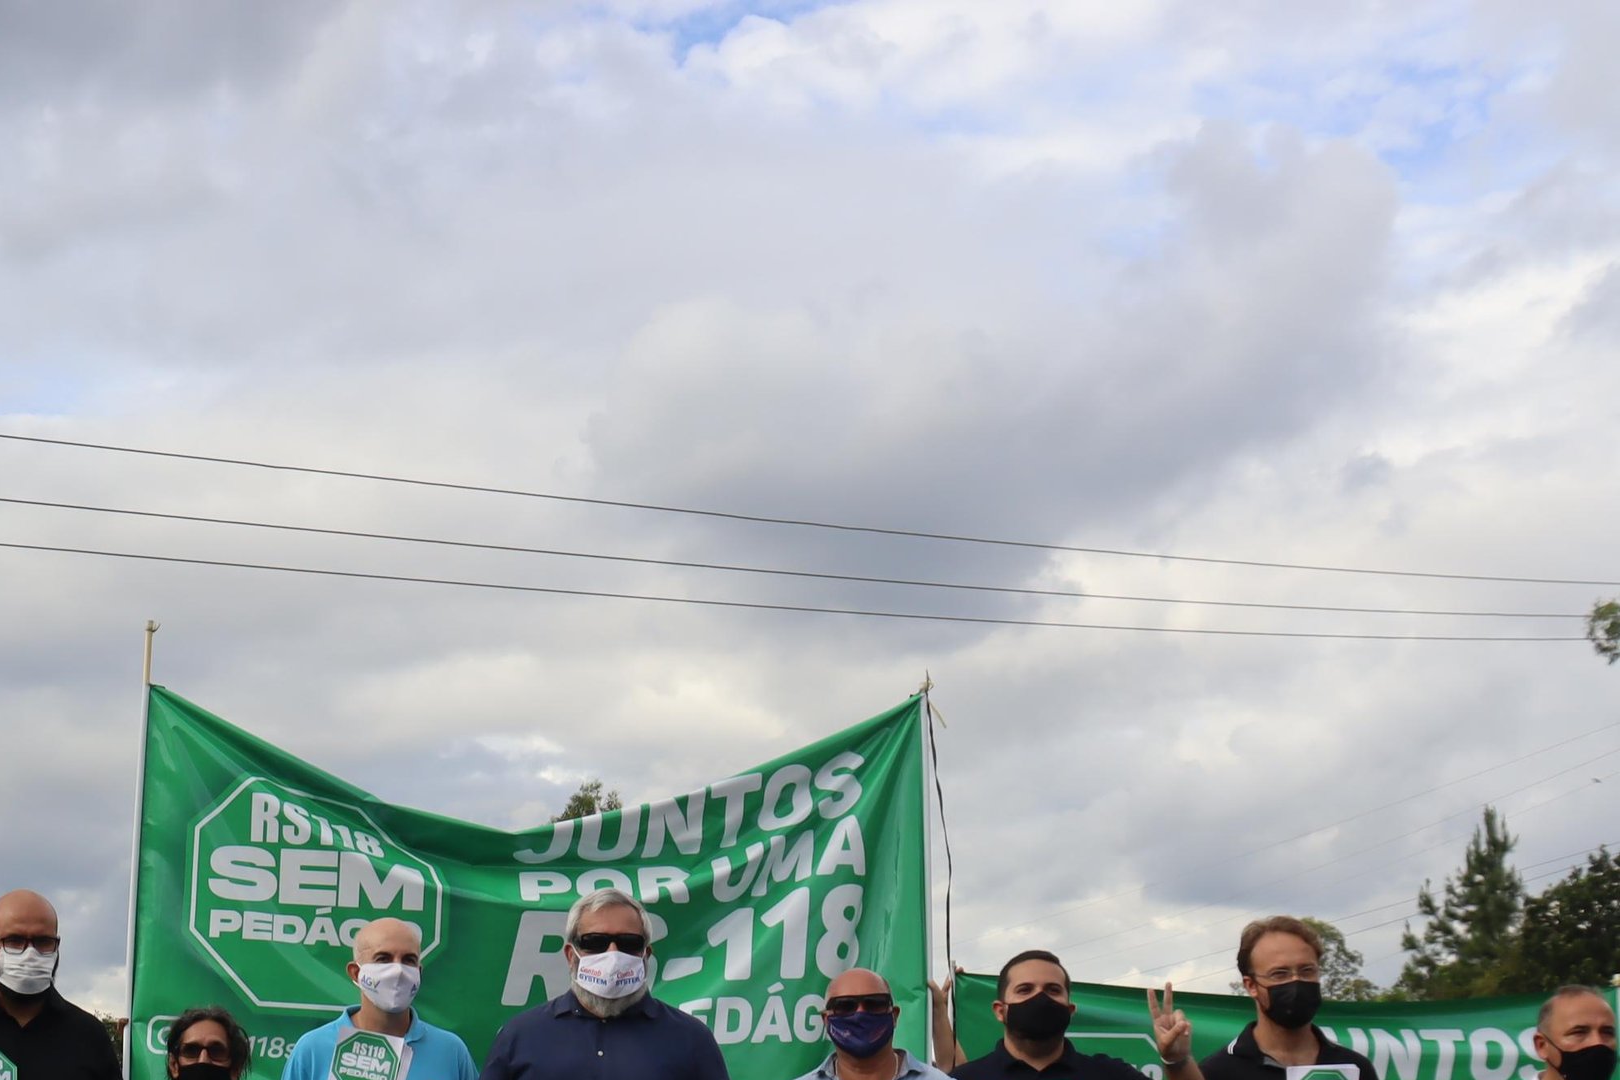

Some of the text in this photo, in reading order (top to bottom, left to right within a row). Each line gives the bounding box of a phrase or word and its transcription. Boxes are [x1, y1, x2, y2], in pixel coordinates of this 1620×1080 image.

[250, 792, 384, 858] RS118
[512, 751, 866, 864] JUNTOS
[208, 844, 425, 911] SEM
[518, 814, 866, 904] POR UMA
[340, 1051, 392, 1075] SEM
[351, 1041, 387, 1060] RS118
